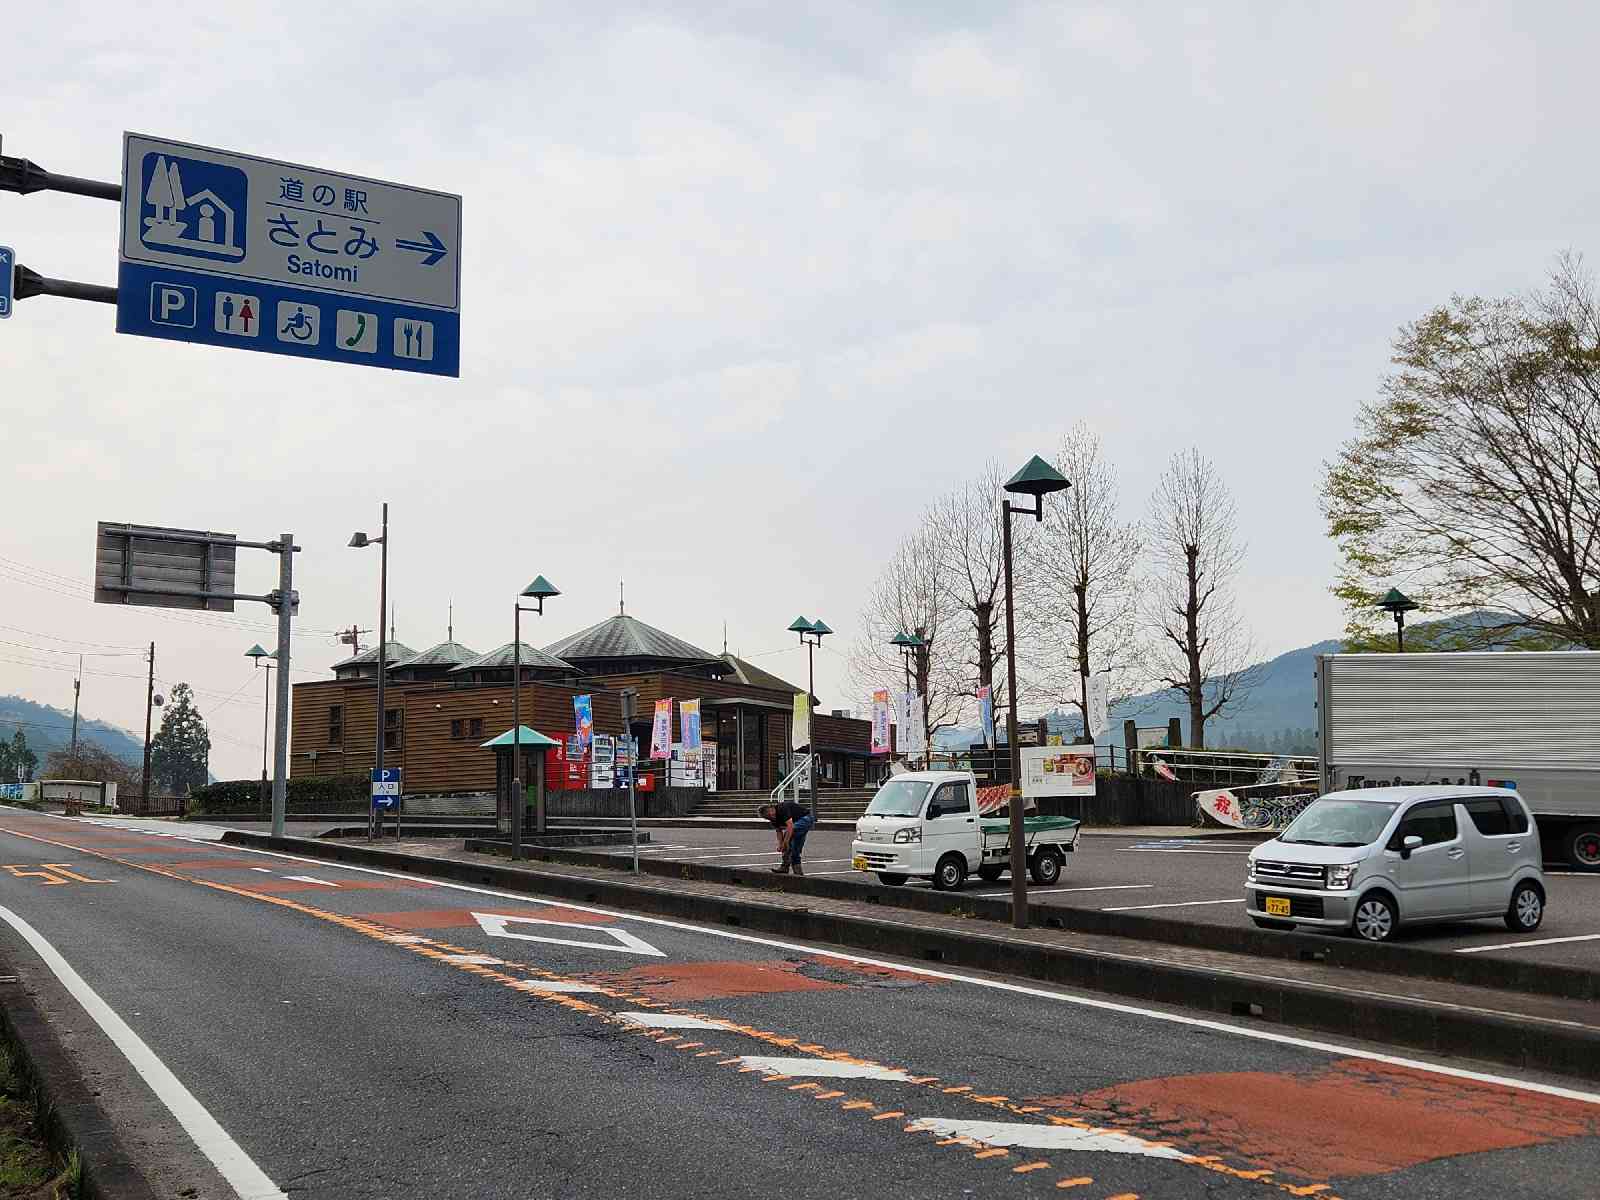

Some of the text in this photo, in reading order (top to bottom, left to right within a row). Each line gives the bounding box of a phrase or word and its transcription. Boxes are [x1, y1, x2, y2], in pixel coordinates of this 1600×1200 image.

[279, 177, 369, 214] 道の駅
[266, 213, 380, 259] さとみ
[287, 254, 358, 282] Satomi
[161, 288, 185, 320] P
[381, 769, 391, 781] P
